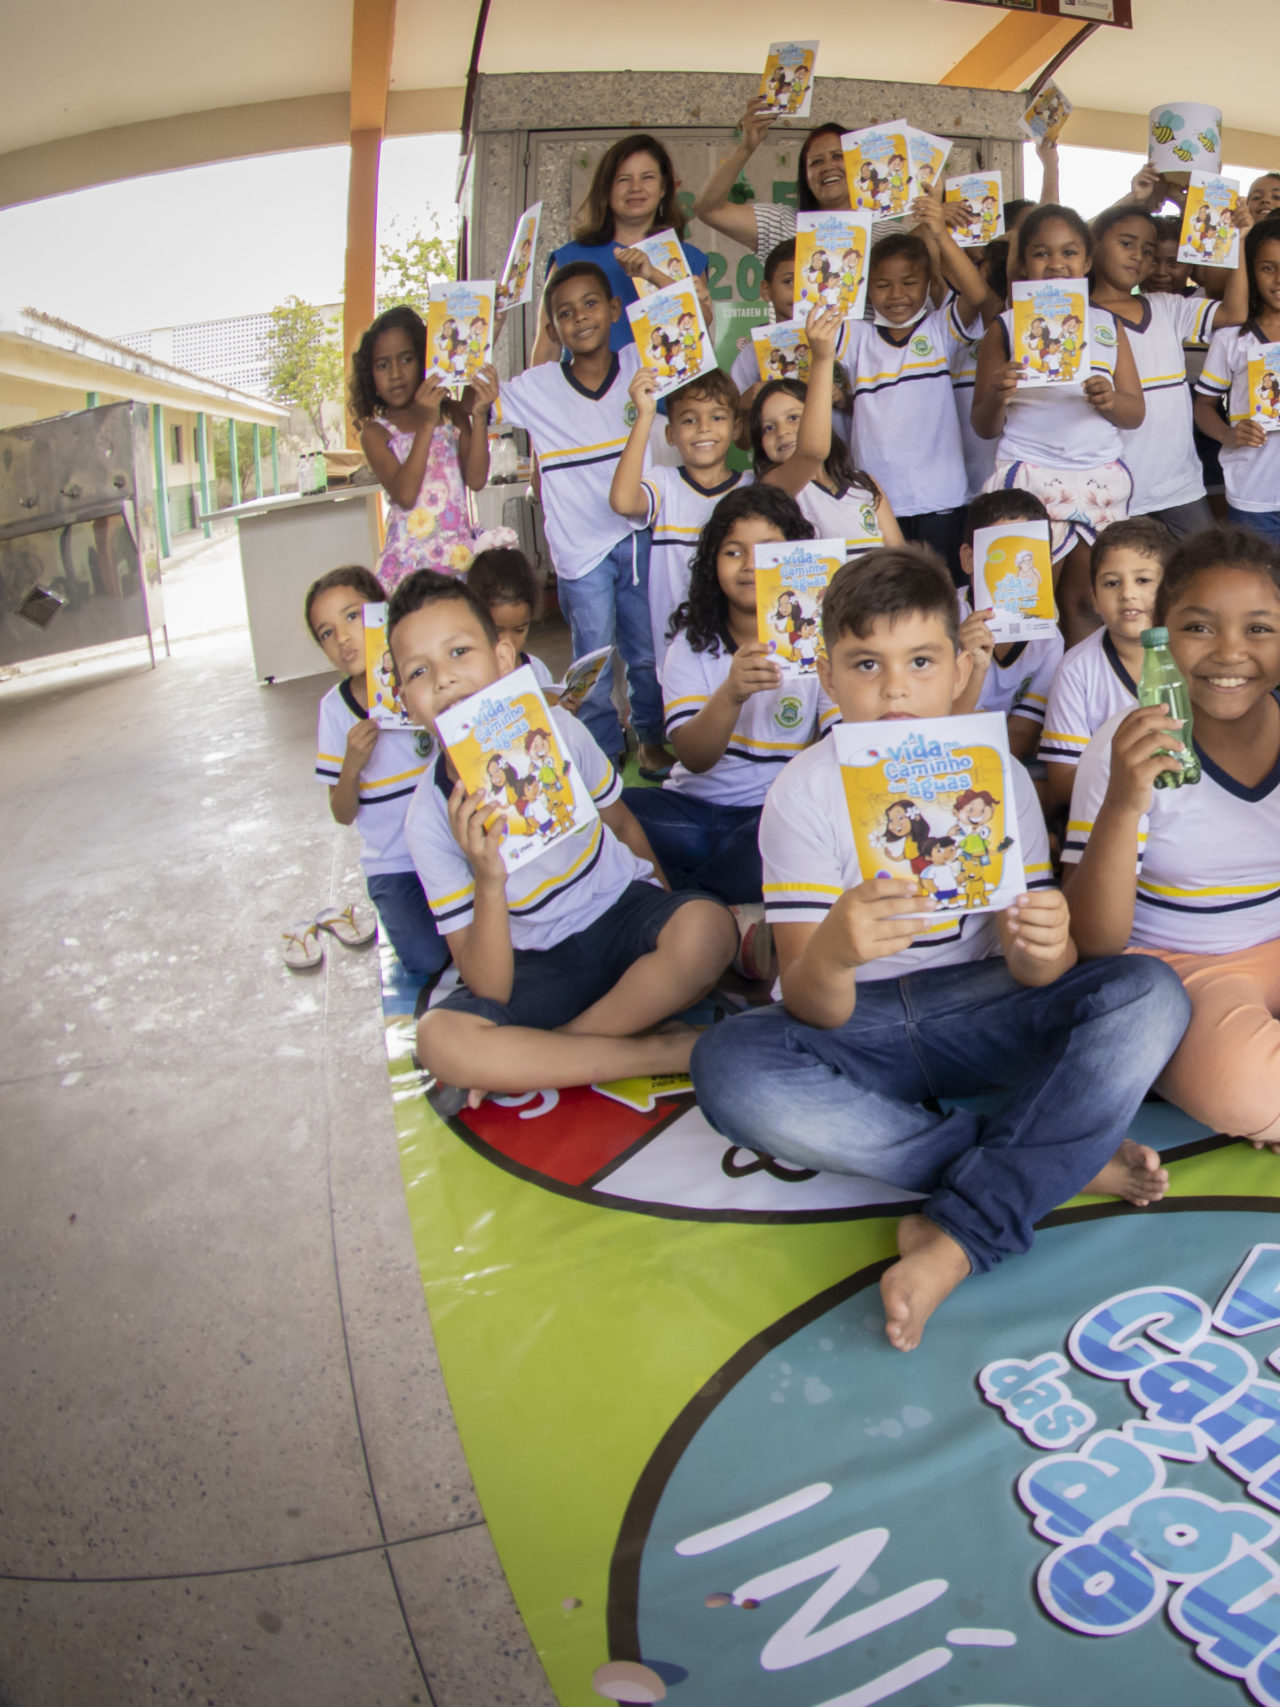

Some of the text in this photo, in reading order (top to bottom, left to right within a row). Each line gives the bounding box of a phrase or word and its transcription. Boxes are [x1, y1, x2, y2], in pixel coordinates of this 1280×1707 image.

[884, 755, 972, 781] Caminho
[908, 774, 971, 801] águas
[978, 1352, 1097, 1450] das
